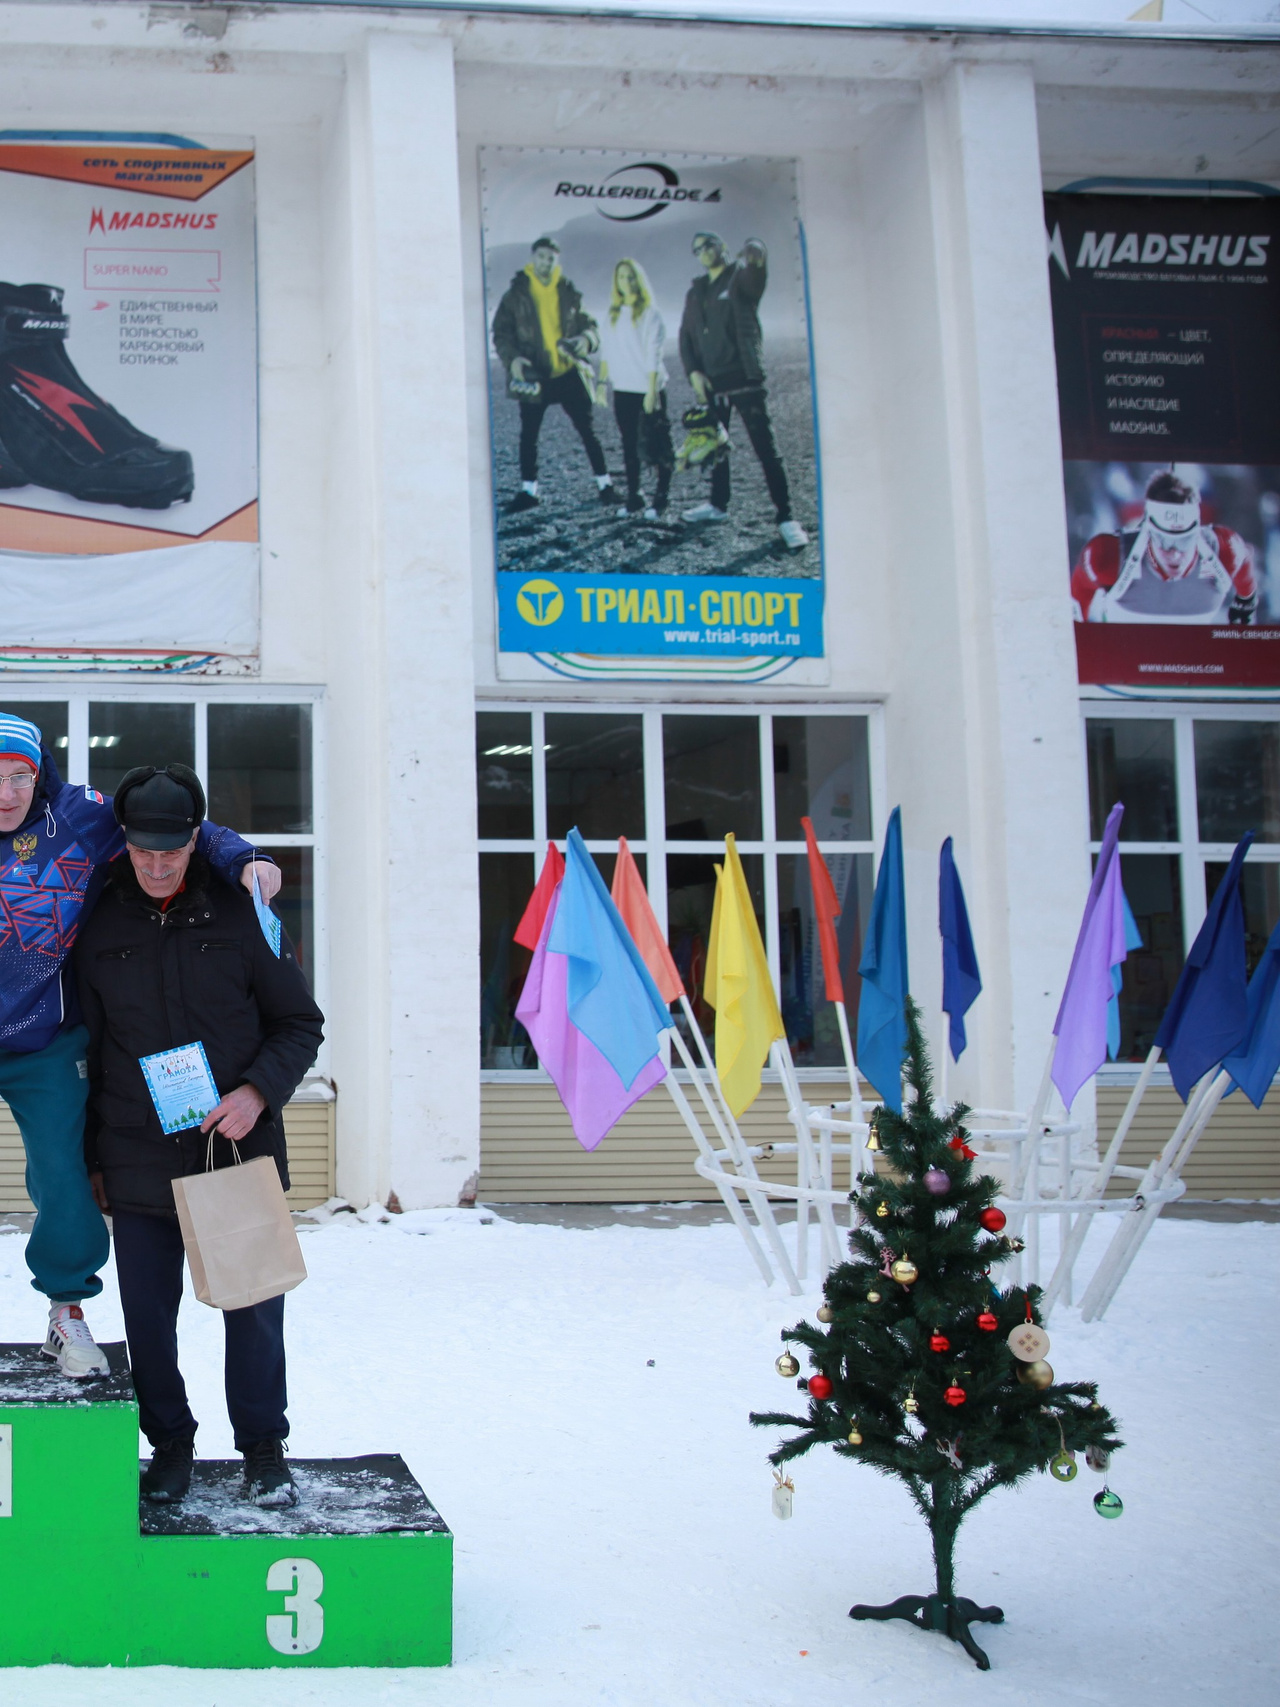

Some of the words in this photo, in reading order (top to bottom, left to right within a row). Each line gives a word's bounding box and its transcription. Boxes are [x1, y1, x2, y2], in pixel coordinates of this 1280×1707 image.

[83, 158, 118, 168] сеть
[124, 158, 226, 171] спортивных
[115, 172, 203, 182] магазинов
[108, 211, 218, 231] MADSHUS
[1075, 231, 1270, 268] MADSHUS
[93, 265, 130, 276] SUPER
[132, 265, 168, 277] NANO
[120, 300, 218, 312] ЕДИНСТВЕННЫЙ
[120, 315, 127, 325] В
[129, 315, 163, 325] МИРЕ
[120, 327, 198, 339] ПОЛНОСТЬЮ
[120, 341, 204, 352] КАРБОНОВЫЙ
[120, 354, 178, 366] БОТИНОК
[1103, 350, 1205, 365] ОПРЕДЕЛЯЮЩИЙ
[1105, 374, 1165, 387] ИСТОРИЮ
[1107, 397, 1117, 409] И
[1119, 398, 1180, 411] НАСЛЕДИЕ
[664, 628, 800, 647] www.trial-sport.ru
[157, 1065, 198, 1082] ГРАМОТА
[265, 1556, 324, 1655] 3
